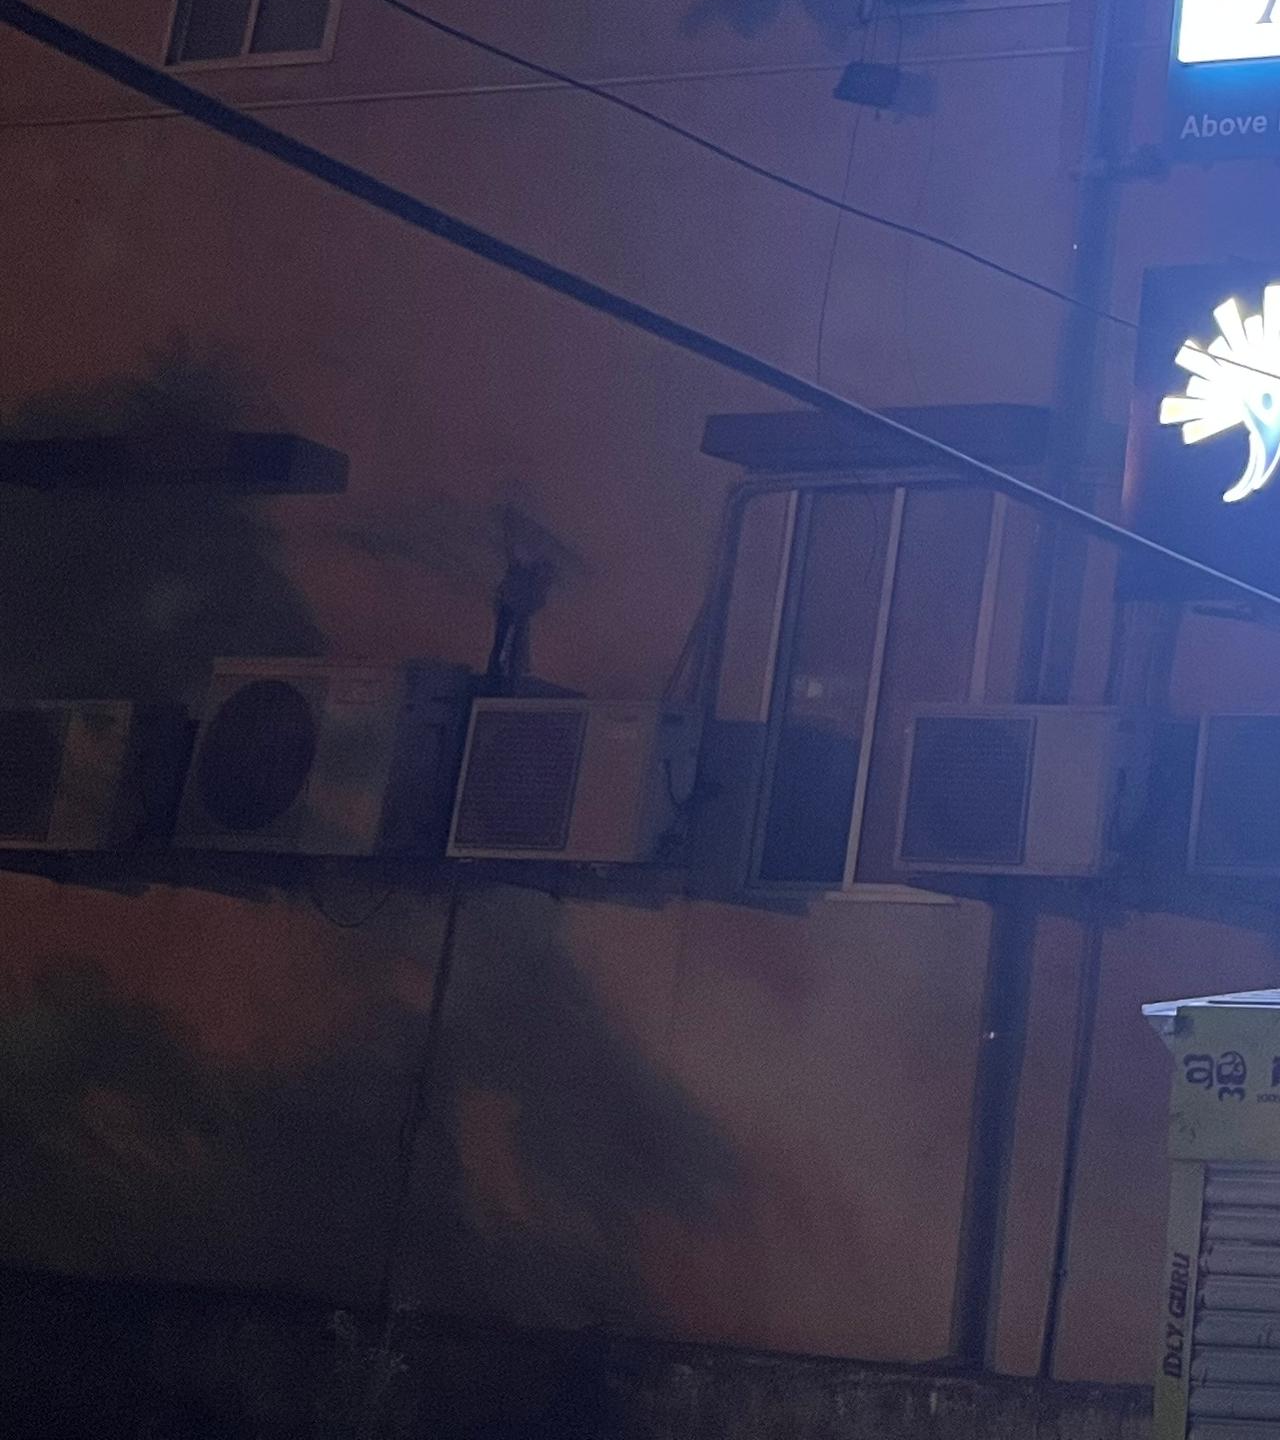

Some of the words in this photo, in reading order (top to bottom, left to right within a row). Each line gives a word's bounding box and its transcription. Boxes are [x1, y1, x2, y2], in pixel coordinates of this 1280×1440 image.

[1180, 114, 1268, 140] Above
[1168, 1251, 1190, 1319] GURU
[1163, 1323, 1184, 1378] IDLY
